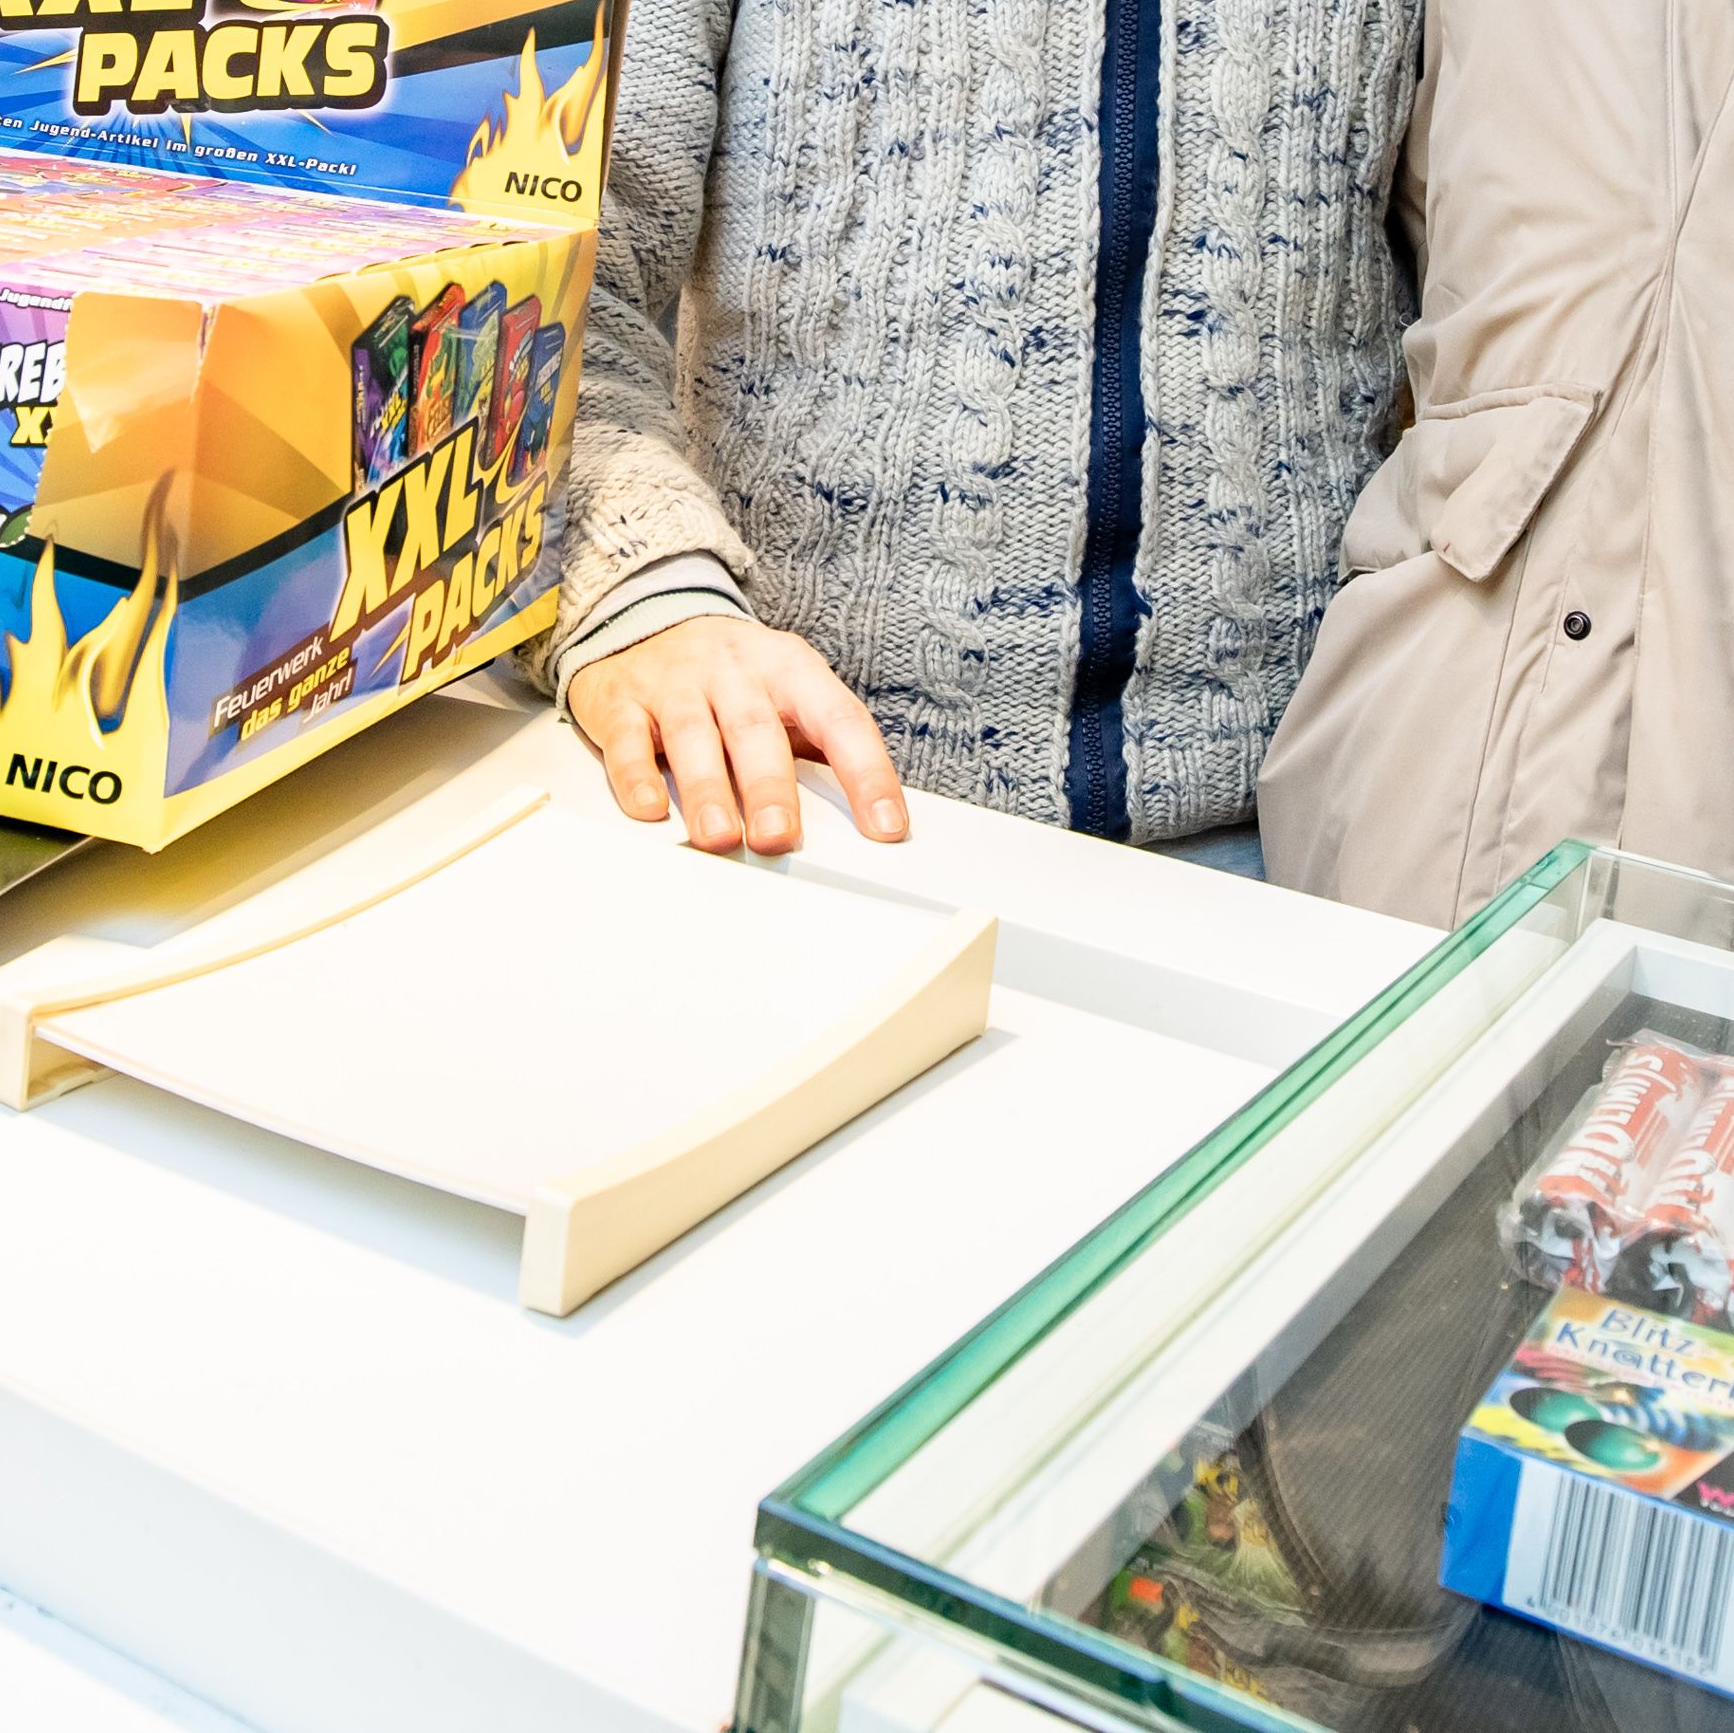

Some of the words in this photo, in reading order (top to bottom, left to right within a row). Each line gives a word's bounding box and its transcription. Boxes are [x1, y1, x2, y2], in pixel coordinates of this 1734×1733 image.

[77, 22, 378, 103] PACKS
[29, 120, 161, 153] Jugend-Artikel
[165, 138, 187, 154] im
[193, 142, 259, 168] großen
[265, 152, 358, 178] XXL-Pack!
[504, 170, 584, 203] NICO
[330, 432, 481, 643] XXL
[400, 479, 547, 683] PACKS
[214, 634, 324, 729] Feuerwerk
[240, 696, 285, 744] das
[286, 646, 352, 715] ganze
[302, 668, 354, 725] Jahr!
[4, 753, 124, 806] NICO
[1602, 1308, 1698, 1358] Blitz
